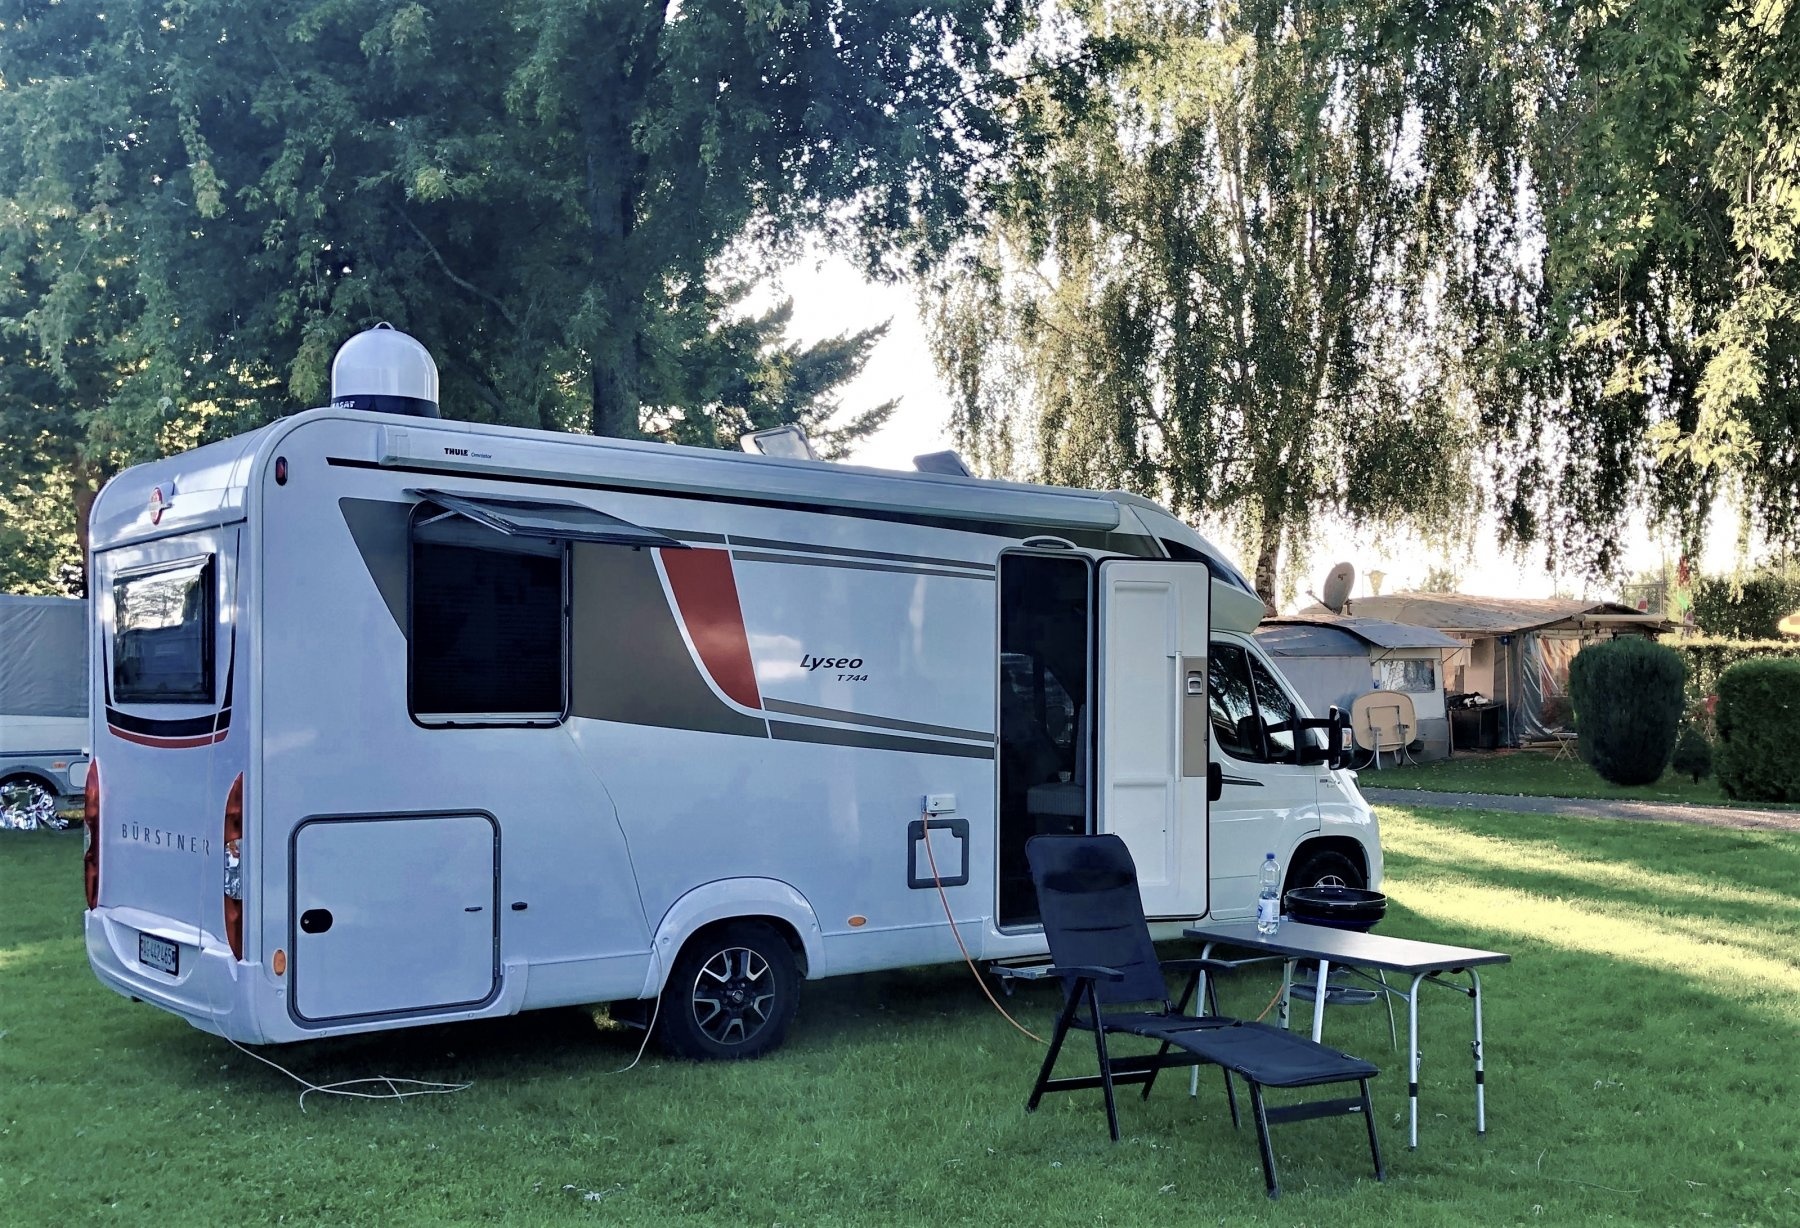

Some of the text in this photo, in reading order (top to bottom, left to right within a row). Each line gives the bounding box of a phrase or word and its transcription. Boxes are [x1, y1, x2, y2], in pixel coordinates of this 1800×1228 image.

[444, 447, 469, 457] THULE
[799, 654, 864, 672] Lyseo
[121, 821, 210, 857] BÜRSTNER
